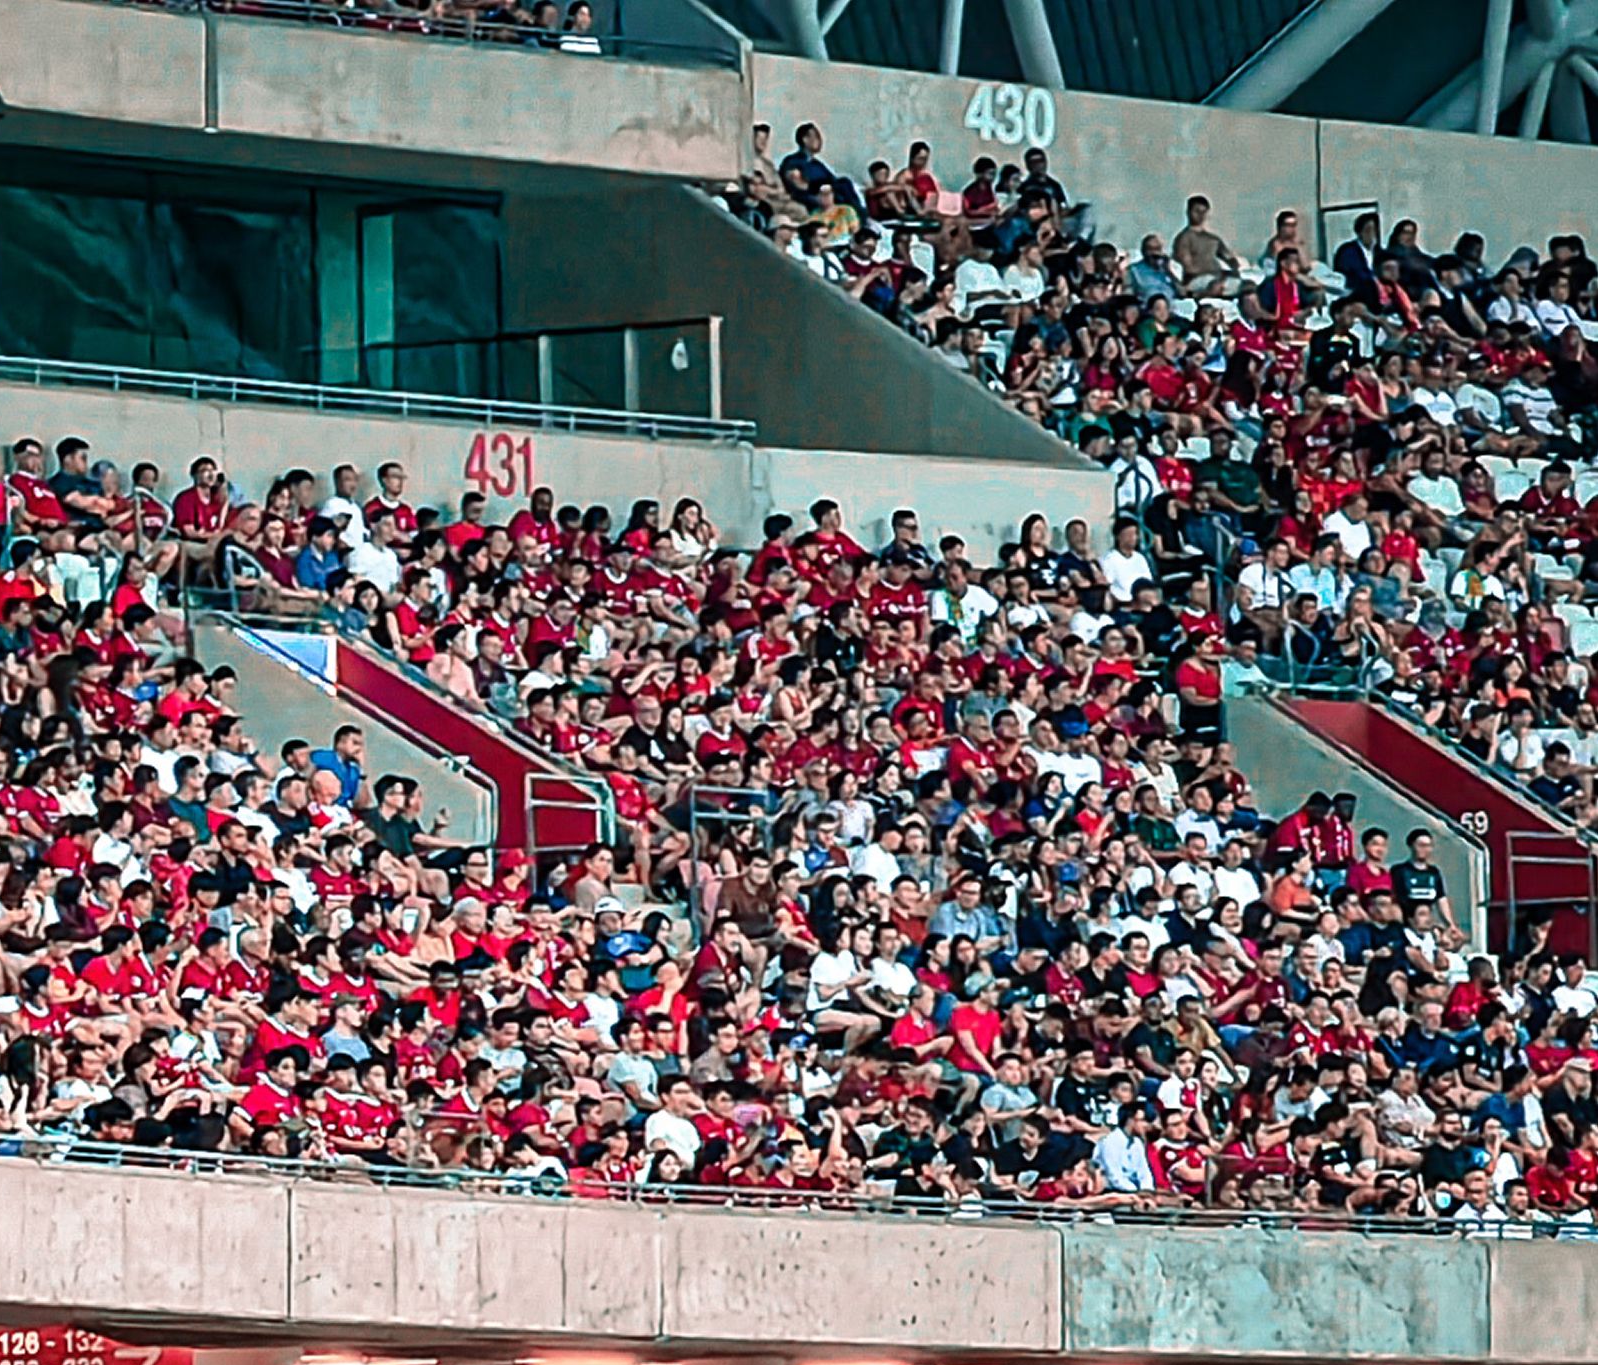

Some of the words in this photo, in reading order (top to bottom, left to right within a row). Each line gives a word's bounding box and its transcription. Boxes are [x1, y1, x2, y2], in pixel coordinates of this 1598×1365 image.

[964, 83, 1055, 148] 430
[465, 432, 533, 498] 431
[63, 1329, 106, 1353] 132
